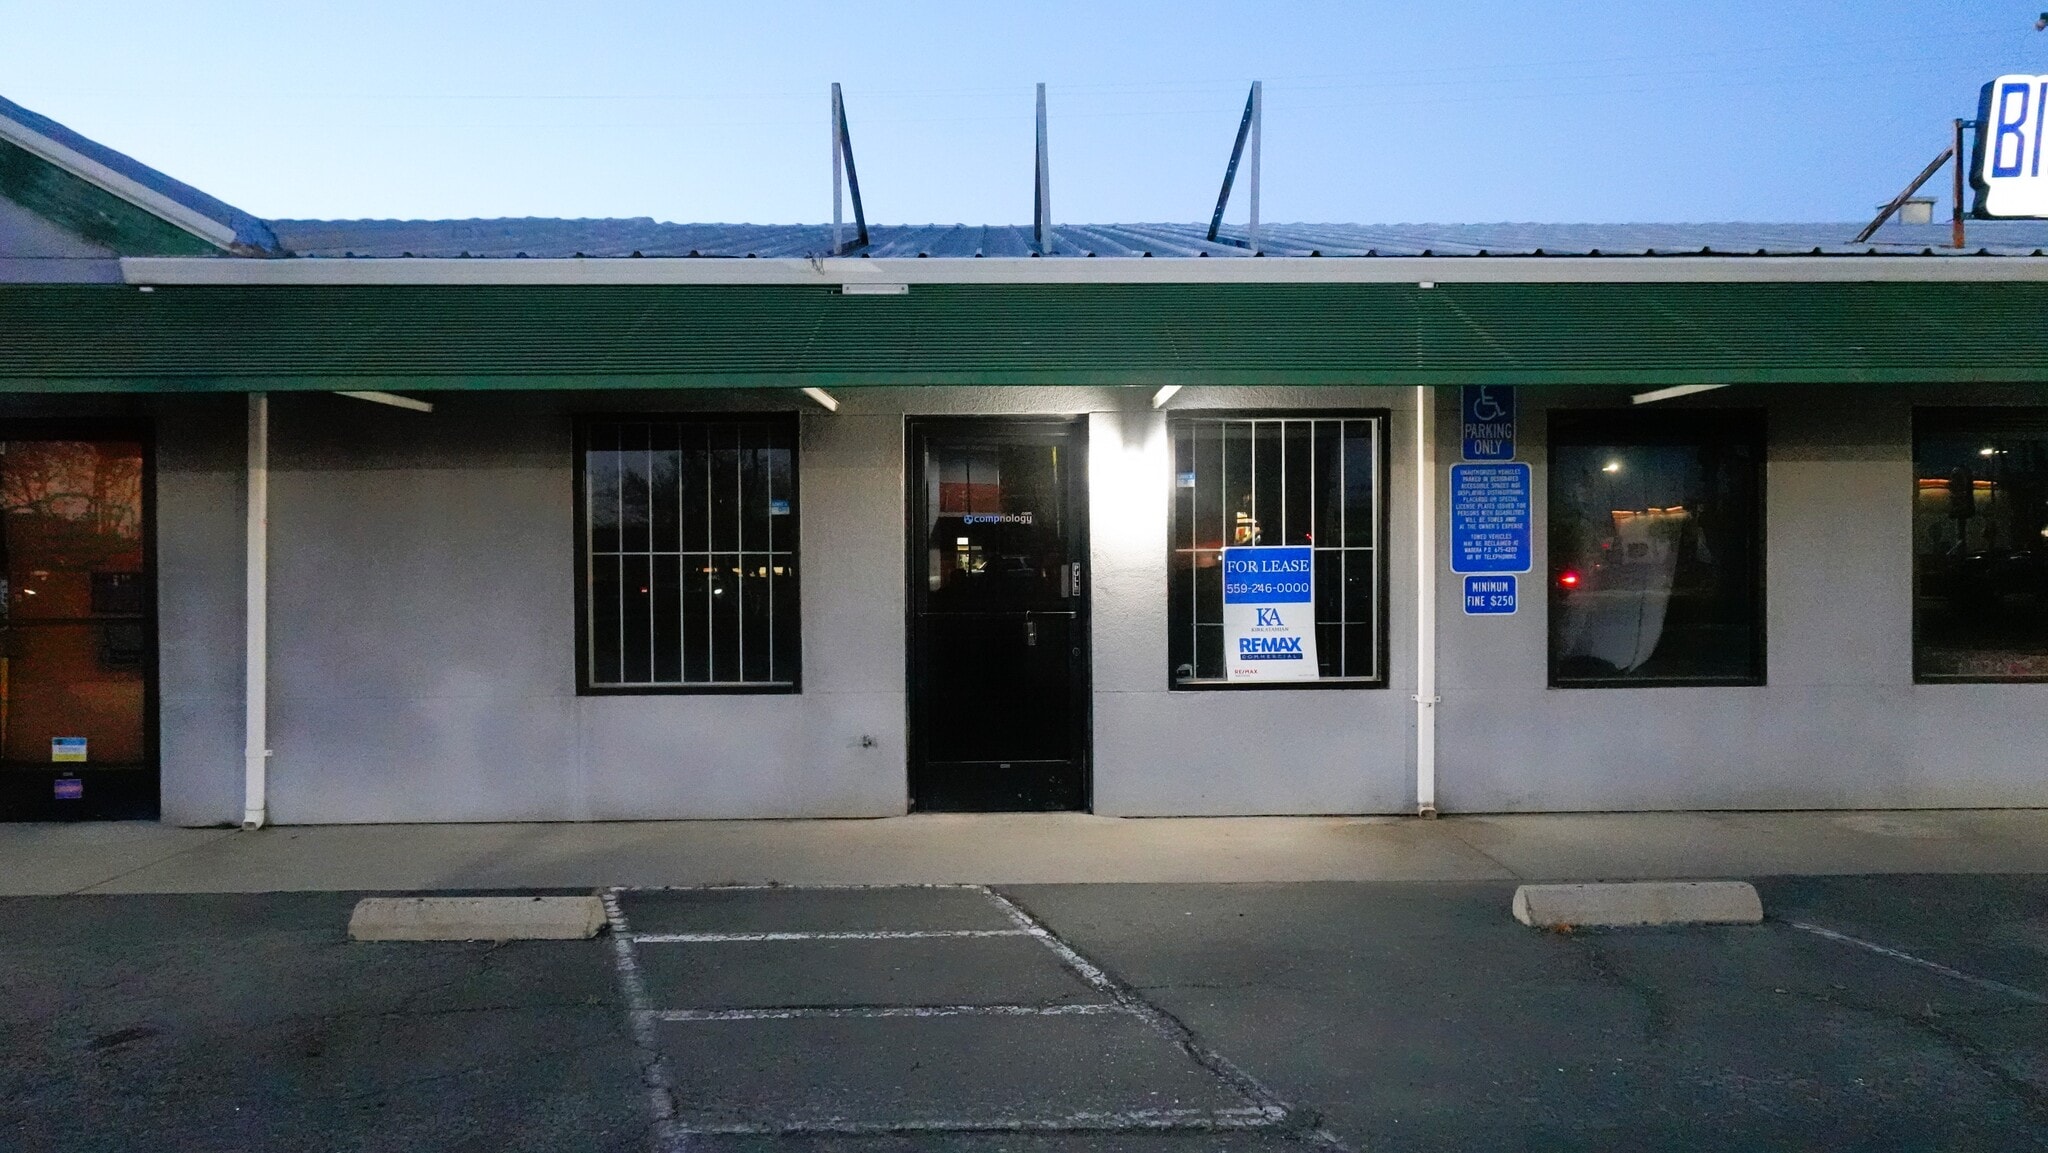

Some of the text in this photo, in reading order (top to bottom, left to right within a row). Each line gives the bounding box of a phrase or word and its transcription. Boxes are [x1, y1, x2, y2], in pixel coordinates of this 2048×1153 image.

[1465, 424, 1512, 438] PARKING
[1474, 440, 1502, 455] ONLY
[974, 513, 1033, 524] compnology
[1227, 559, 1310, 573] FOR LEASE
[1226, 583, 1309, 594] 559-246-0000
[1472, 582, 1508, 592] MINIMUM
[1467, 595, 1514, 606] FINE $250
[1256, 608, 1284, 626] KA
